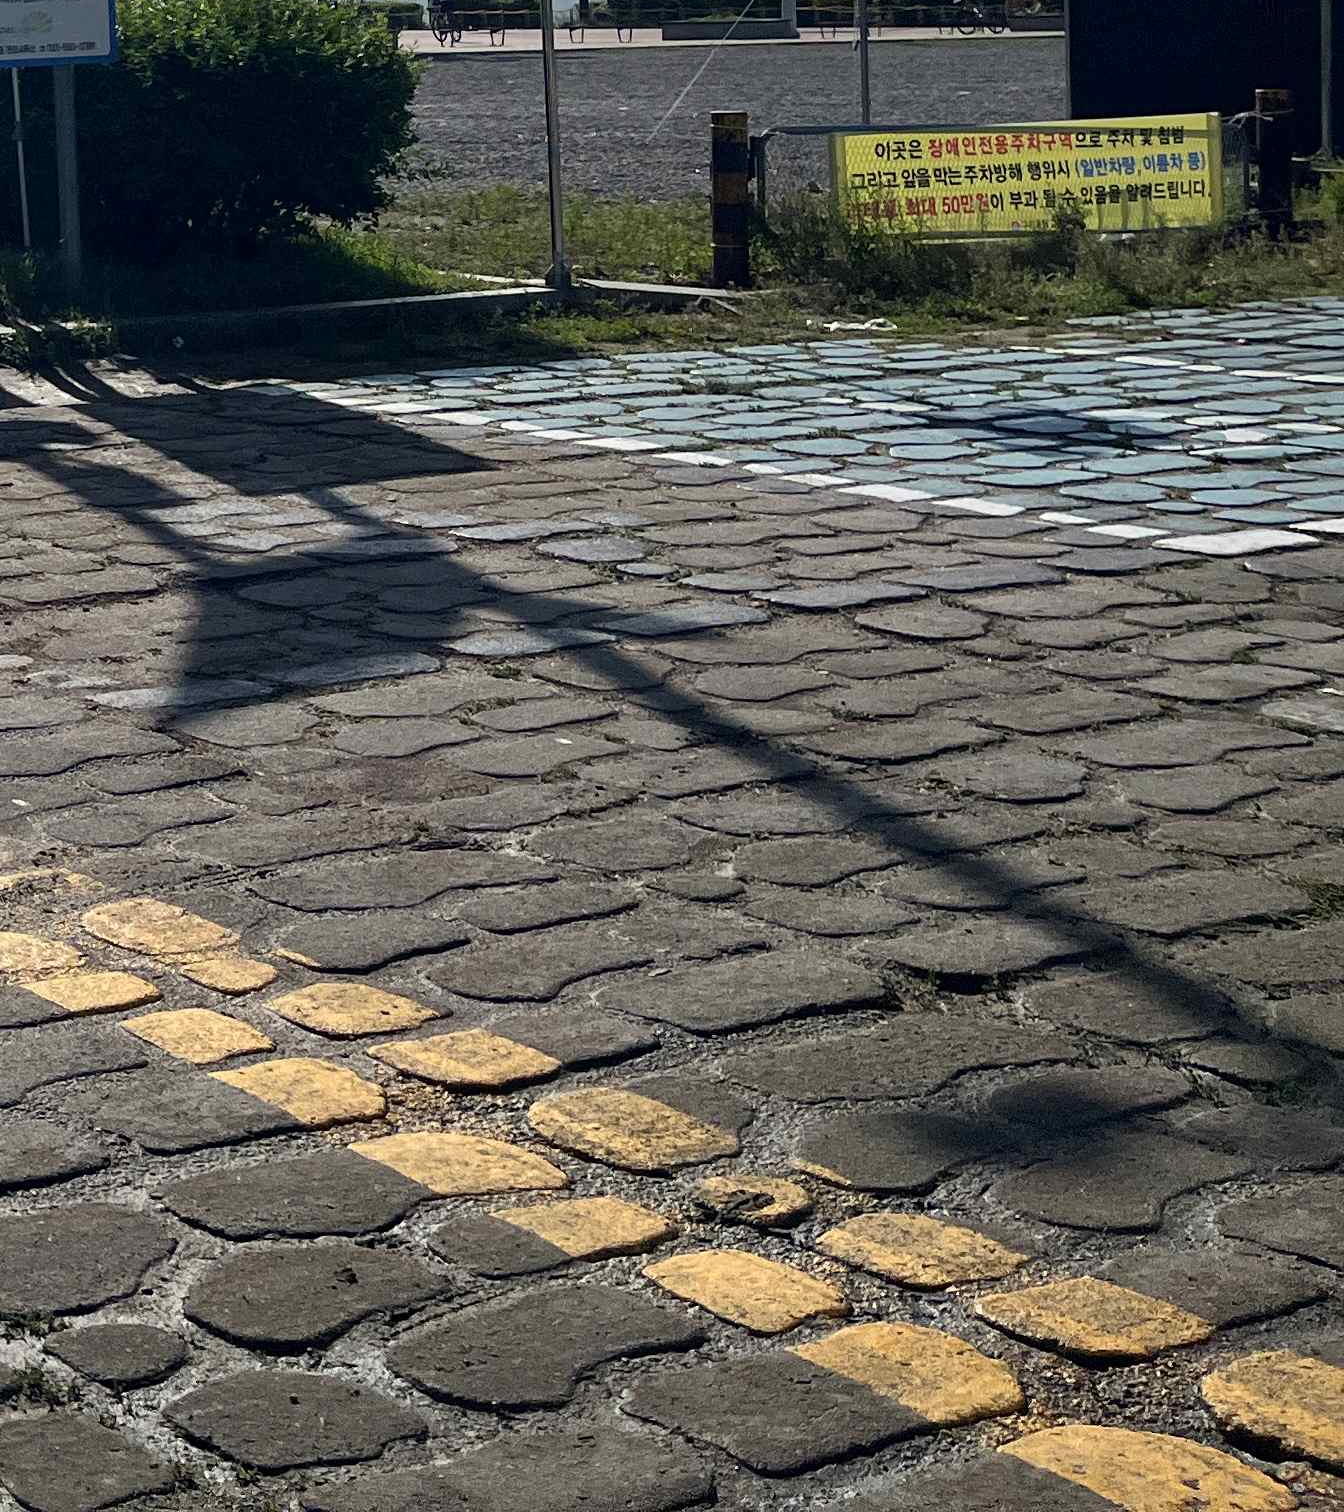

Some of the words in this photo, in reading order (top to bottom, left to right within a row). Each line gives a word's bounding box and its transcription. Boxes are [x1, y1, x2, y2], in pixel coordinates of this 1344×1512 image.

[874, 139, 923, 162] 이곳은
[1107, 129, 1136, 148] 주차
[1140, 128, 1153, 146] 및
[1027, 159, 1071, 181] 행위시
[1009, 190, 1039, 210] 부과
[1080, 184, 1121, 206] 있음을
